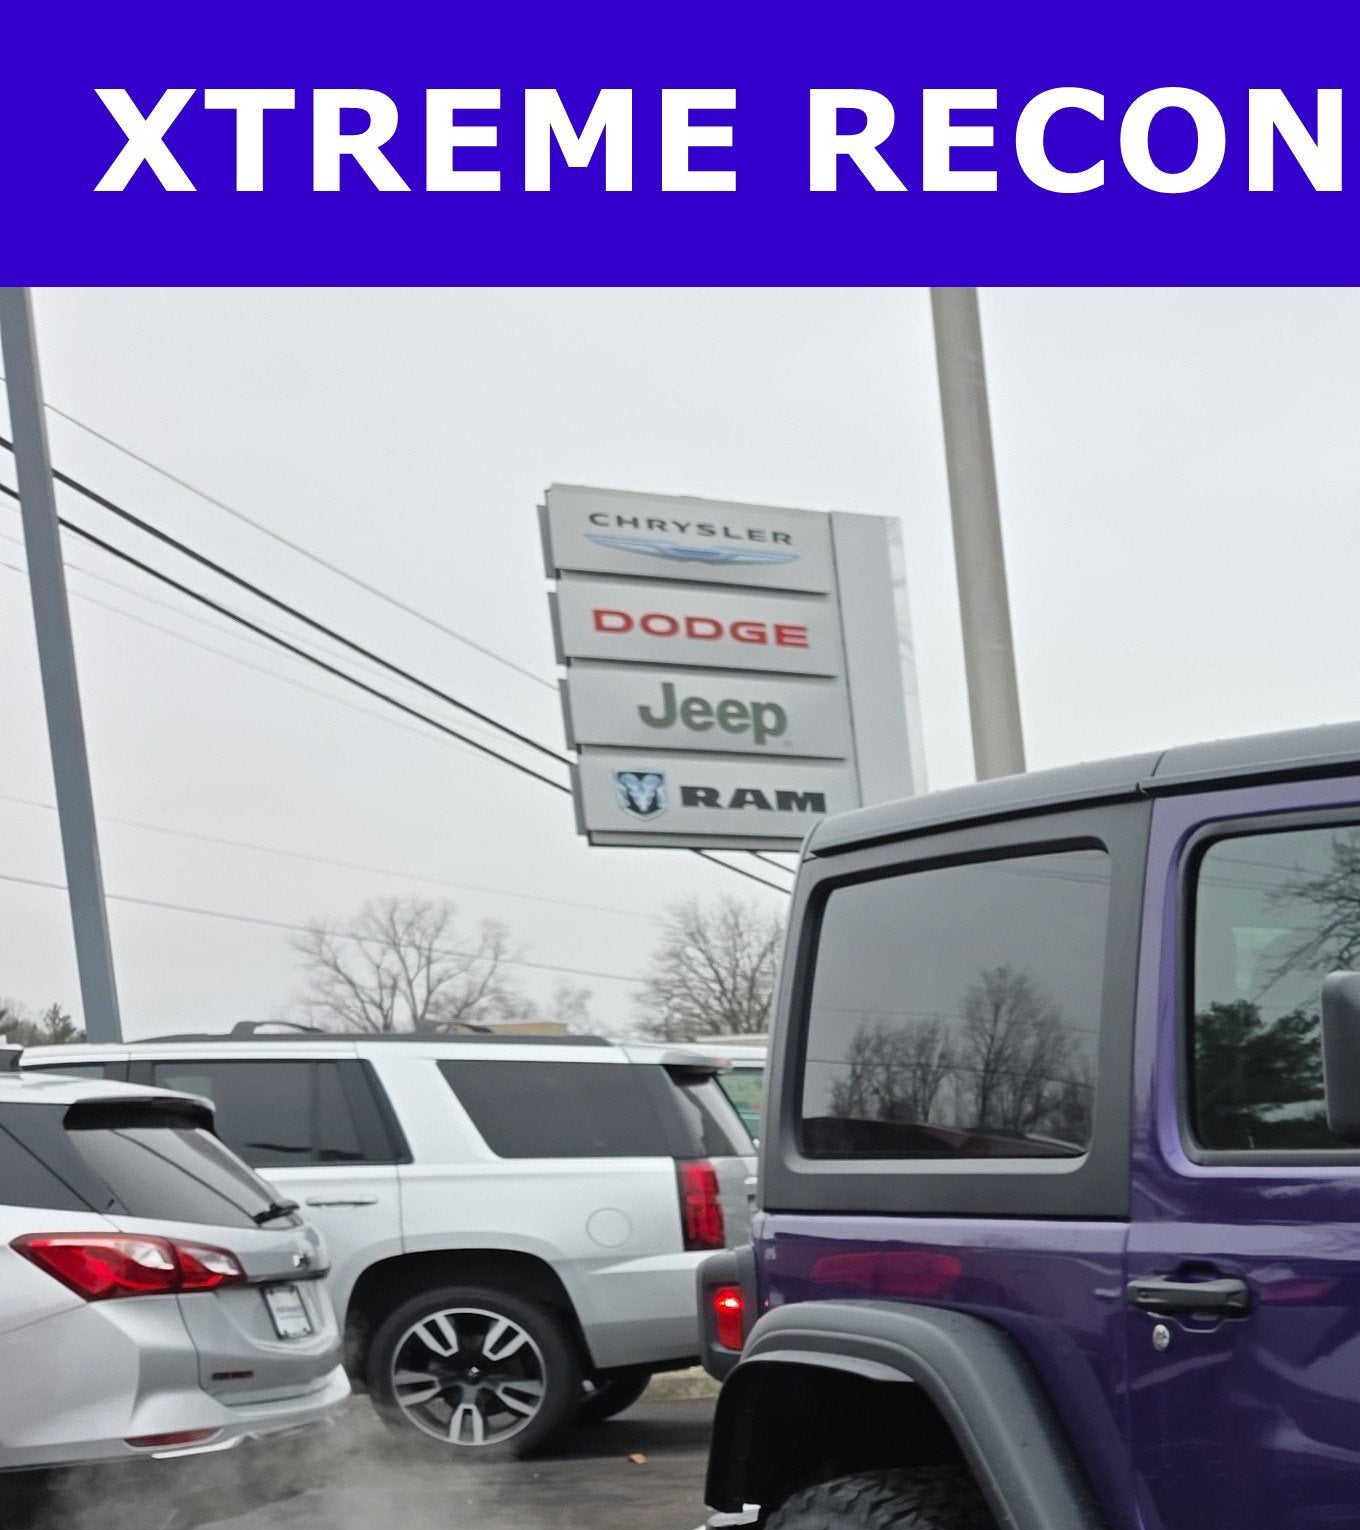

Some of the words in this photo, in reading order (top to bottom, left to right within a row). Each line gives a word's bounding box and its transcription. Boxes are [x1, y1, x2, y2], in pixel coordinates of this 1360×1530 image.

[588, 512, 793, 546] CHRYSLER
[592, 608, 811, 649] DODGE
[638, 682, 789, 746] Jeep
[680, 785, 828, 814] RAM
